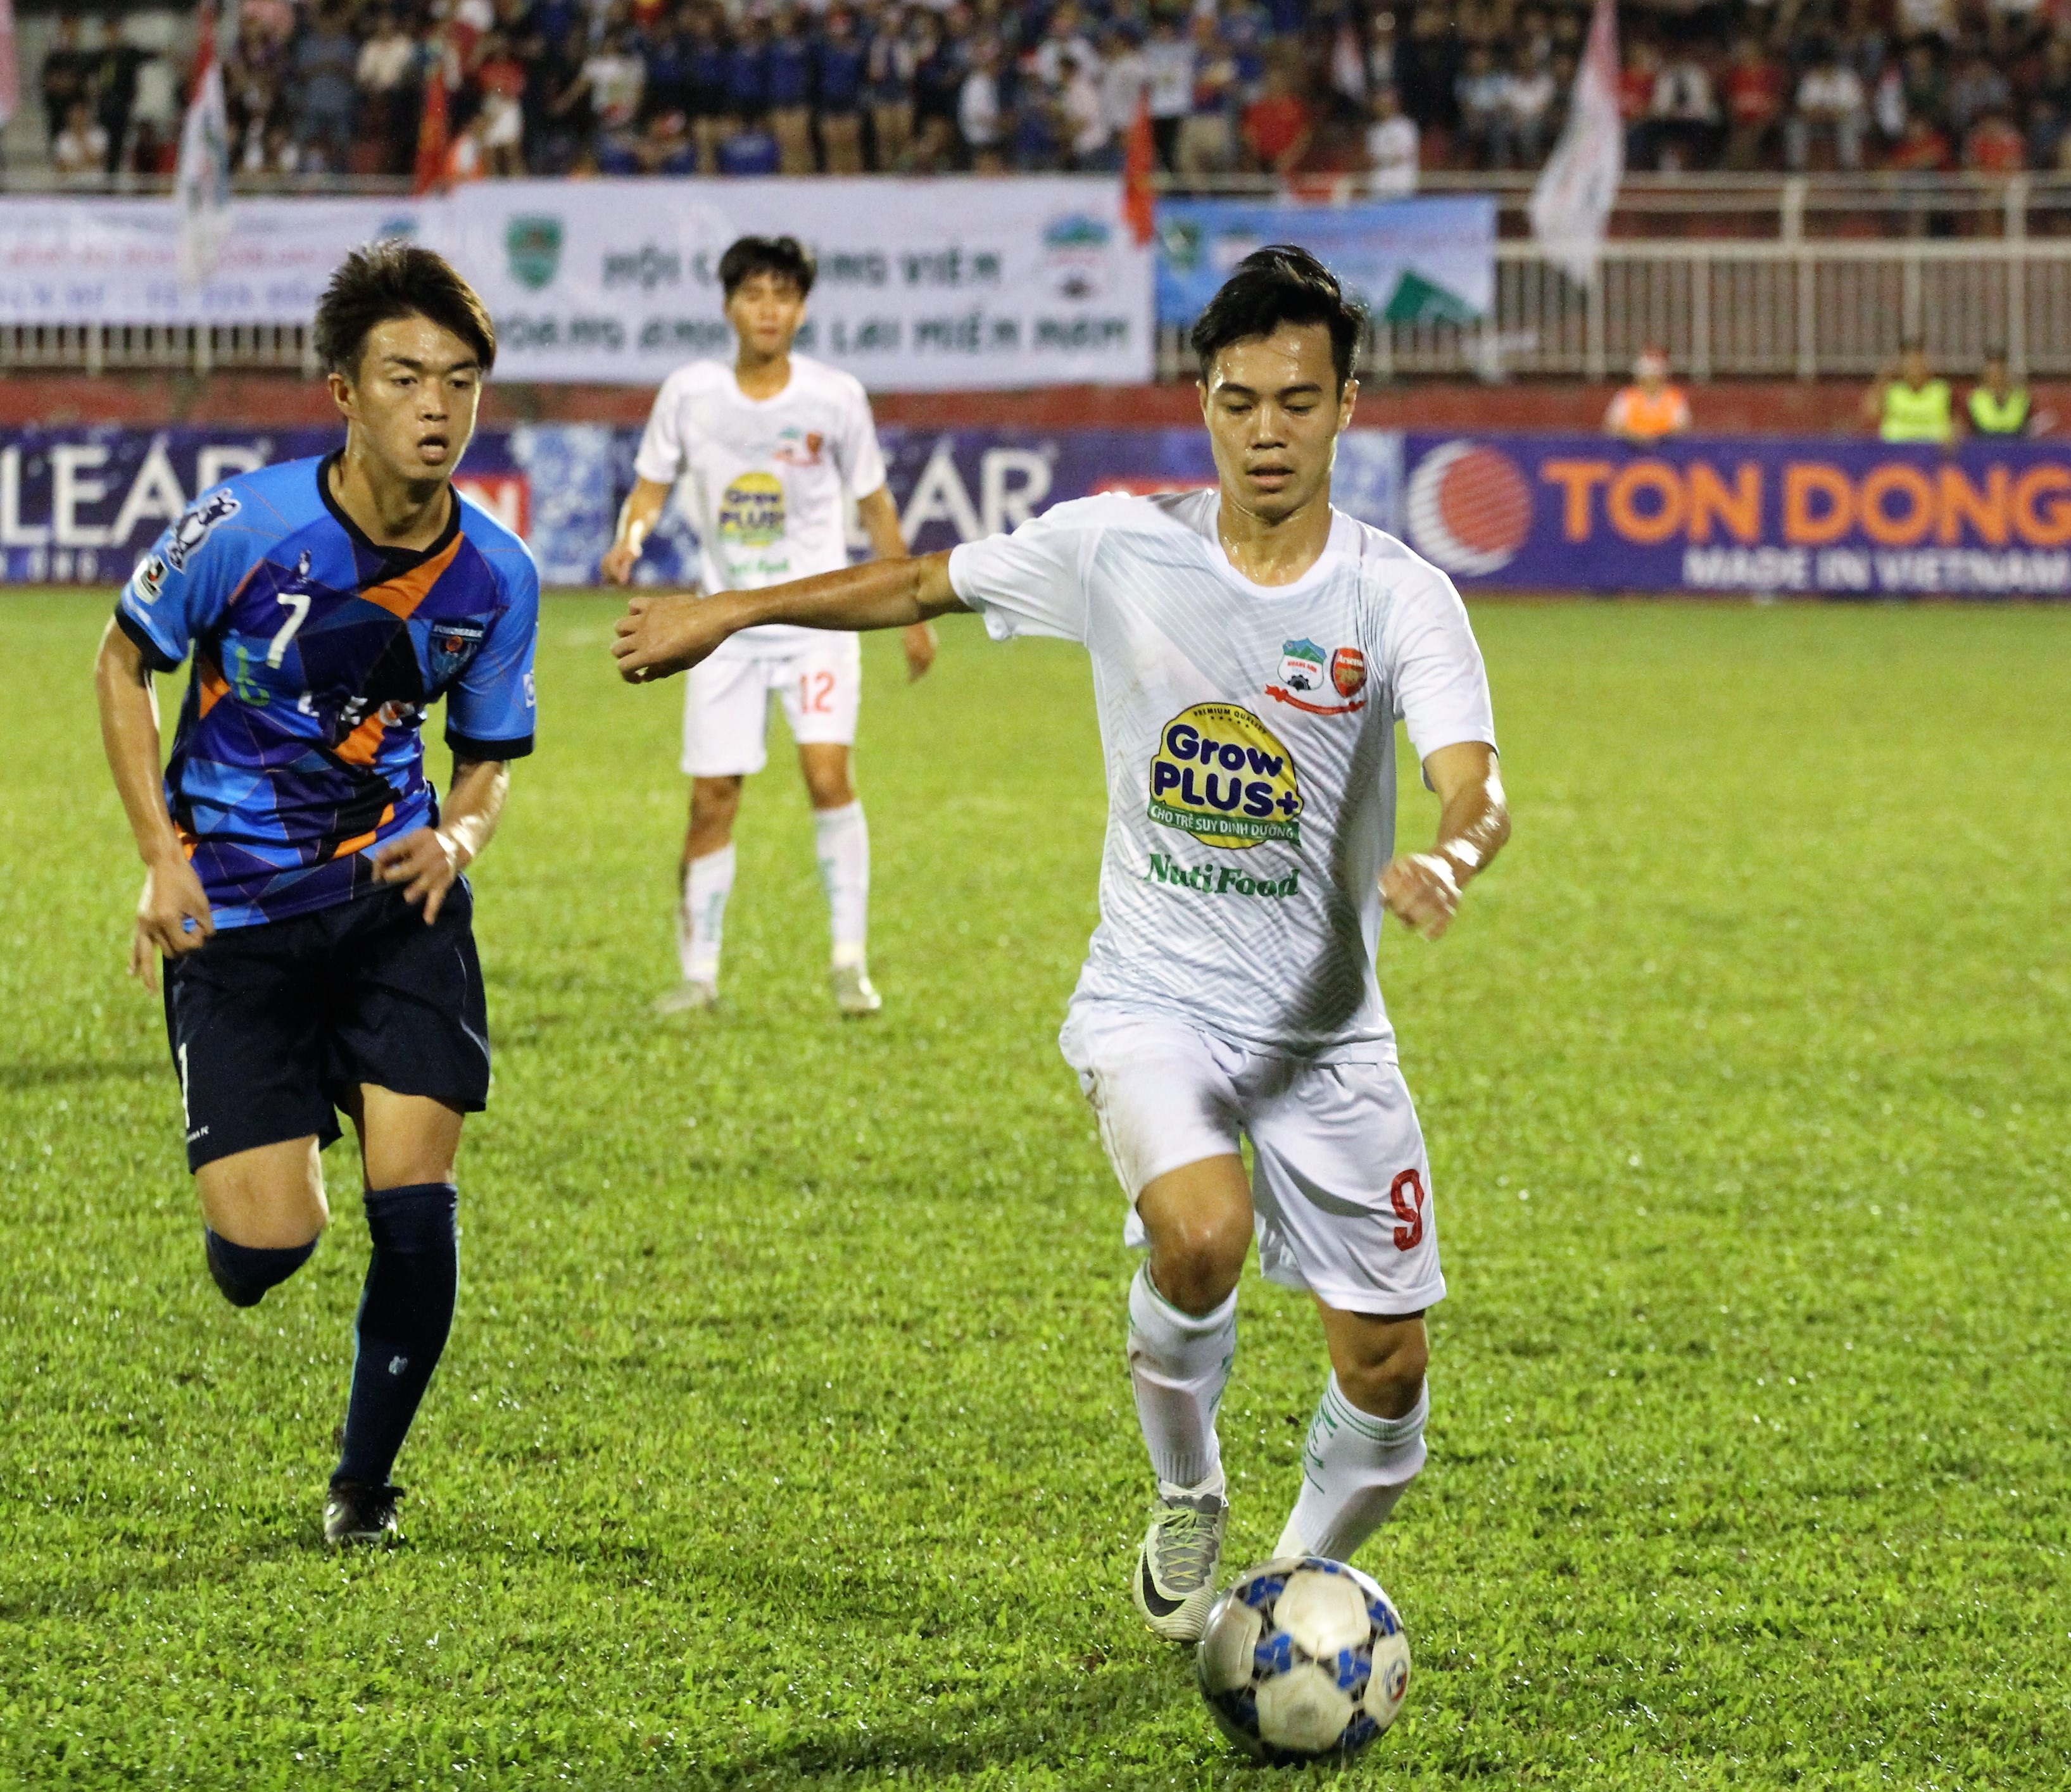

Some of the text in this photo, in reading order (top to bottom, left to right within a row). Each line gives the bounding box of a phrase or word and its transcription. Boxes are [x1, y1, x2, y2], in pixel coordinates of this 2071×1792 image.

[1540, 457, 2071, 547] TON DONG
[1683, 546, 1806, 590] MADE
[1815, 548, 1872, 590] IN
[266, 592, 312, 669] 7
[800, 671, 835, 714] 12
[1193, 708, 1266, 734] PREMIUM QUALITY
[1167, 724, 1283, 777] Grow
[1155, 761, 1298, 817] PLUS+
[1150, 805, 1171, 822] CHO
[1175, 813, 1193, 828] TRẺ
[1195, 818, 1217, 832] SUY
[1390, 1169, 1425, 1251] 9
